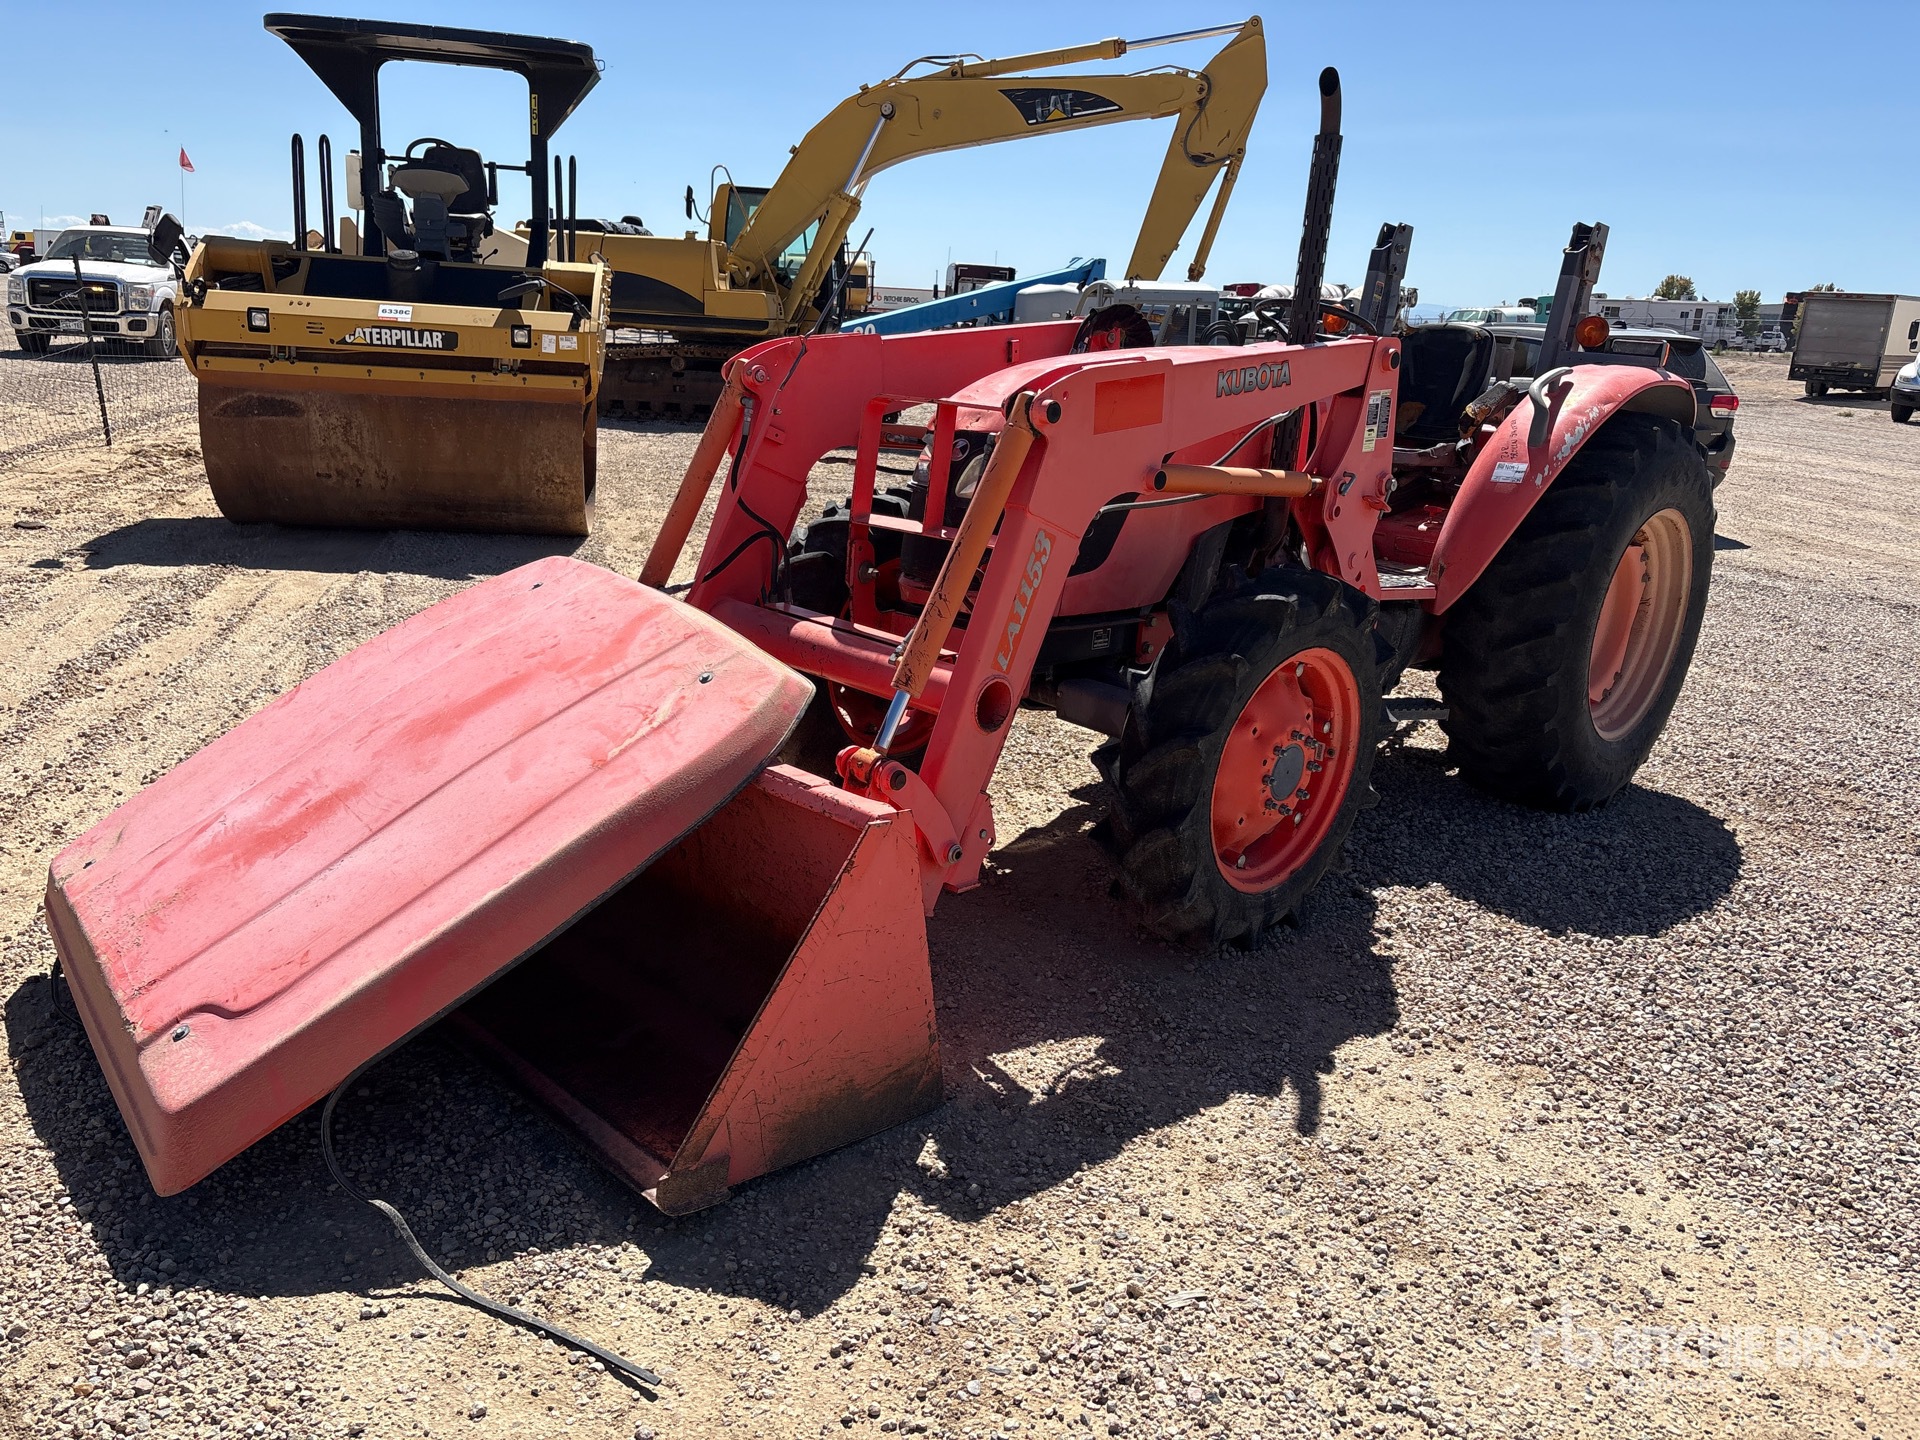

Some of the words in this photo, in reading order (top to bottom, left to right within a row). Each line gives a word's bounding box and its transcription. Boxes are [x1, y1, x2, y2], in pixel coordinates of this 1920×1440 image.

[883, 295, 903, 303] RITCHIE
[345, 327, 443, 348] CATERPILLAR
[1216, 360, 1291, 398] KUBOTA
[997, 529, 1051, 671] LA1153
